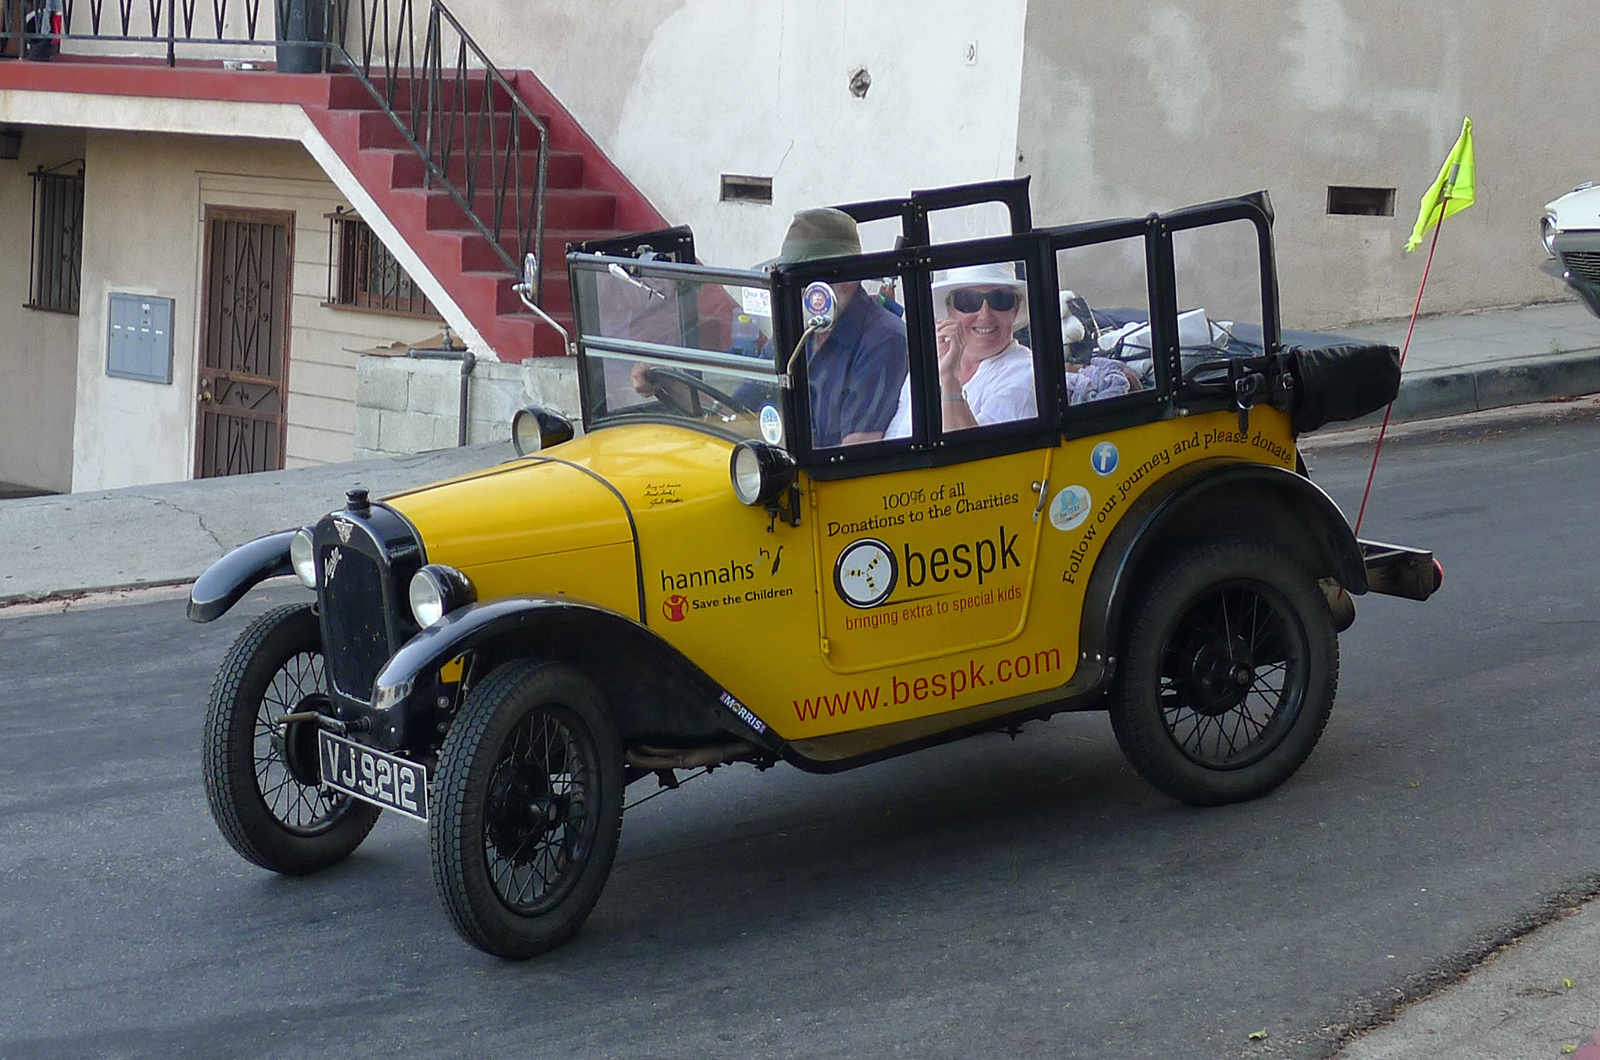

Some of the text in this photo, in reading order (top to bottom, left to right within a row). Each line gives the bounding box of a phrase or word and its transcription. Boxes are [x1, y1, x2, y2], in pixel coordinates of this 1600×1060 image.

[827, 493, 1019, 537] Donations to the Charities
[882, 482, 966, 510] 100% of all
[1062, 428, 1292, 585] Follow our journey and please donate
[660, 559, 755, 592] hannahs
[904, 525, 1021, 588] bespk
[692, 587, 793, 610] Save the Children
[846, 585, 1022, 631] bringing extra to special kids
[793, 647, 1061, 722] www.bespk.com
[723, 694, 763, 730] MORRIS
